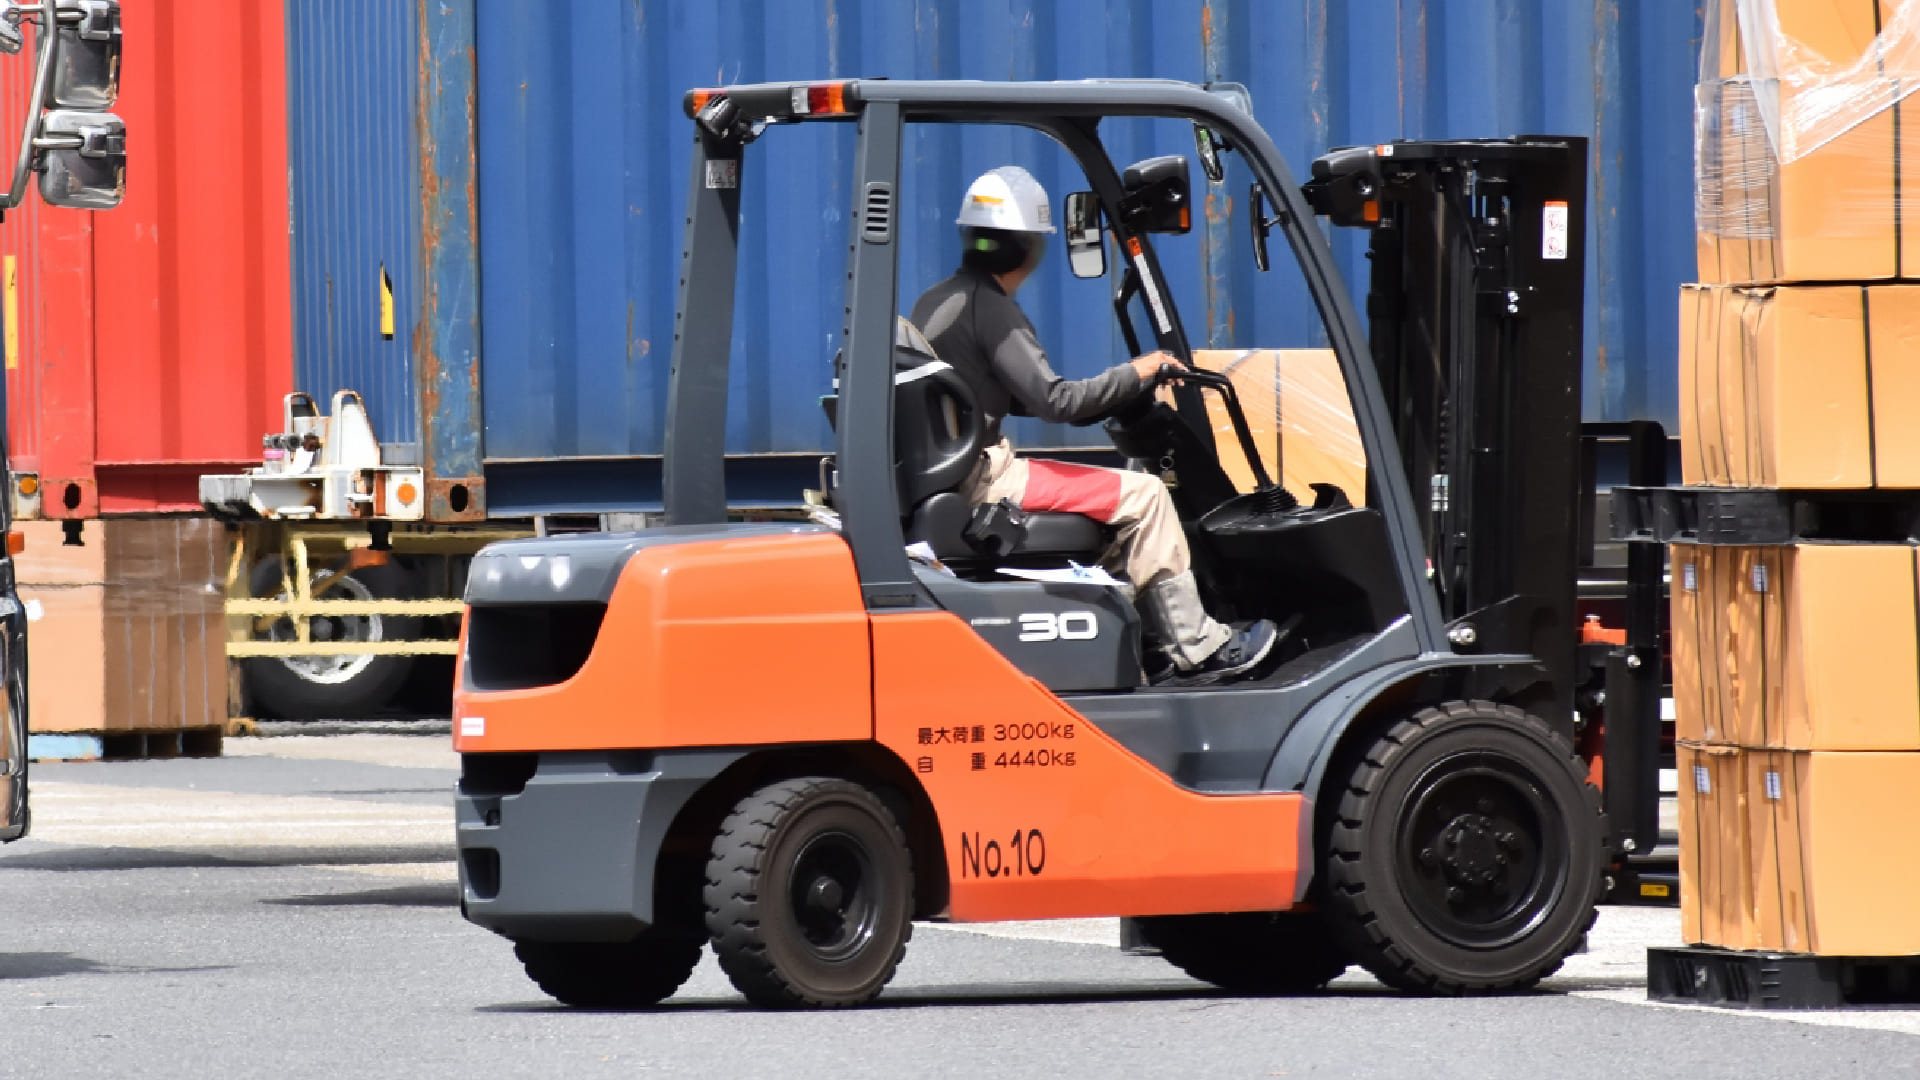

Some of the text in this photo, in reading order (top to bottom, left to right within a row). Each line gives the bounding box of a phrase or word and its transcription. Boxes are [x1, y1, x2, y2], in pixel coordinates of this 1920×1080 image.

[1018, 611, 1099, 642] 30
[917, 722, 1075, 744] 最大荷重 3000kg
[994, 749, 1076, 768] 4440kg
[962, 829, 1046, 879] No.10
